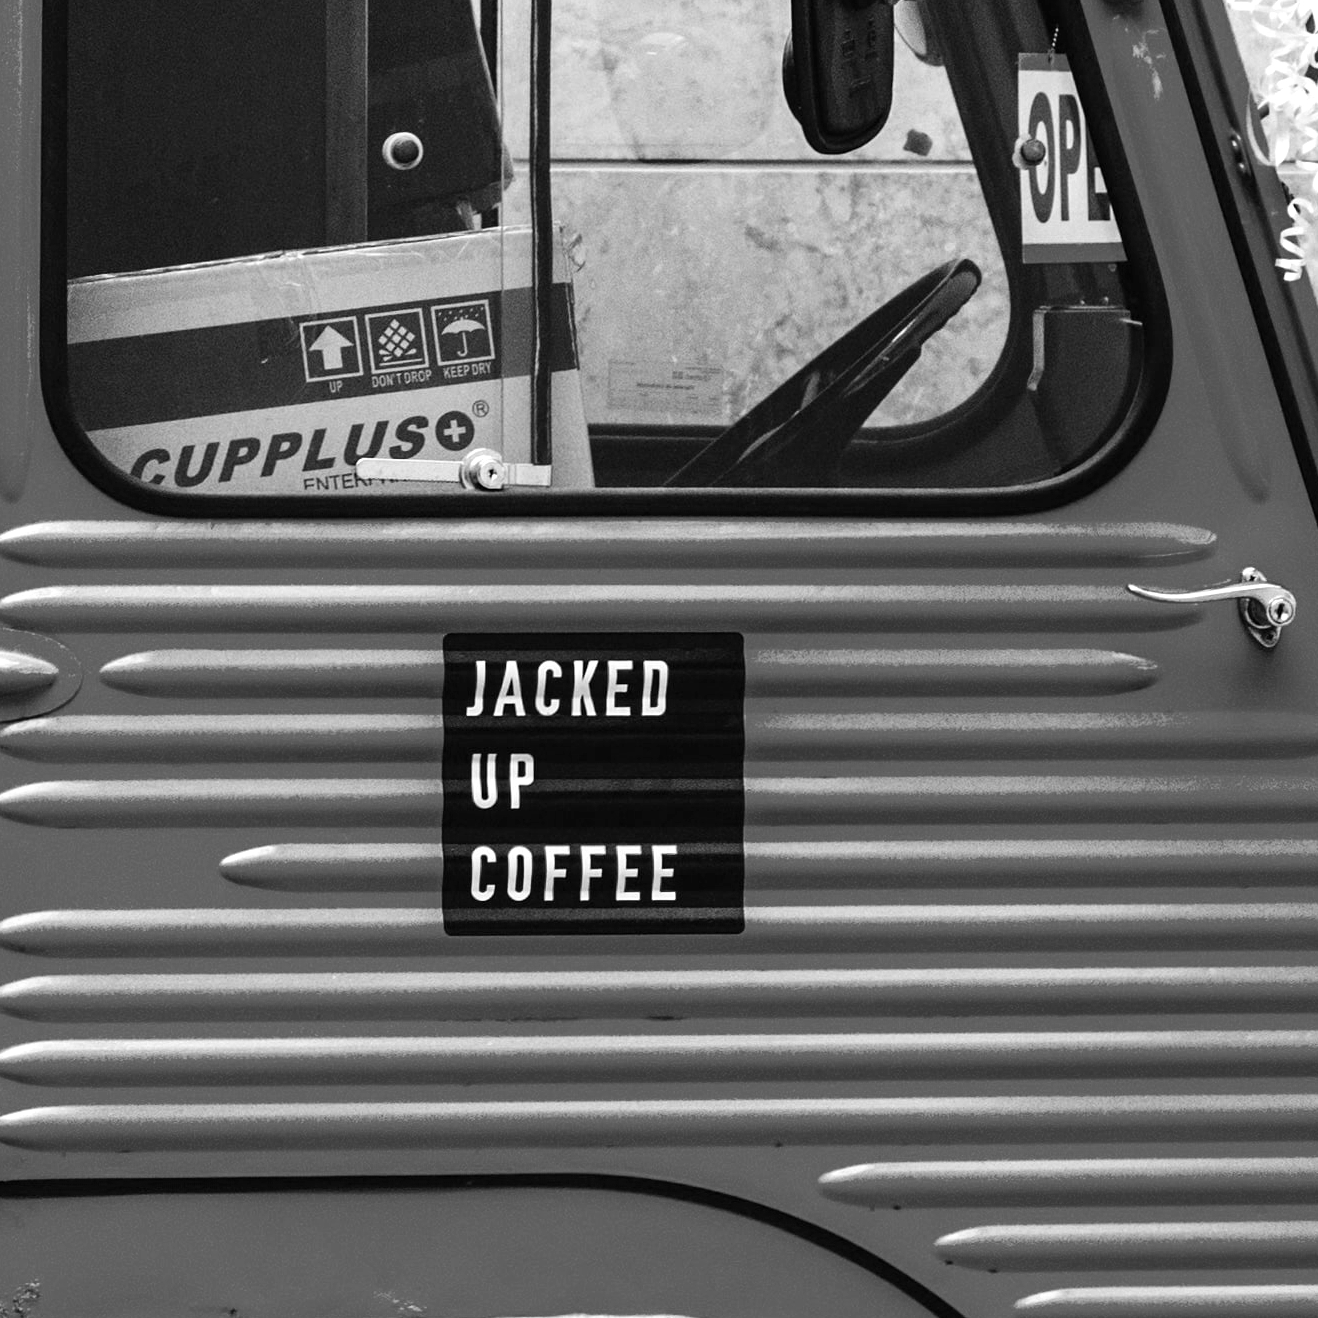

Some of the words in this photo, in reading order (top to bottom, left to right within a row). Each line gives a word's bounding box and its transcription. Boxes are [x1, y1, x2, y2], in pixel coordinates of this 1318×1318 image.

[328, 379, 344, 394] UP
[371, 372, 402, 388] DON'T
[403, 368, 433, 385] DROP
[442, 364, 470, 380] KEEP
[471, 361, 492, 377] DRY
[130, 415, 431, 489] CUPPLUS
[465, 659, 670, 717] JACKED
[470, 752, 536, 810] UP
[470, 844, 679, 902] COFFEE
